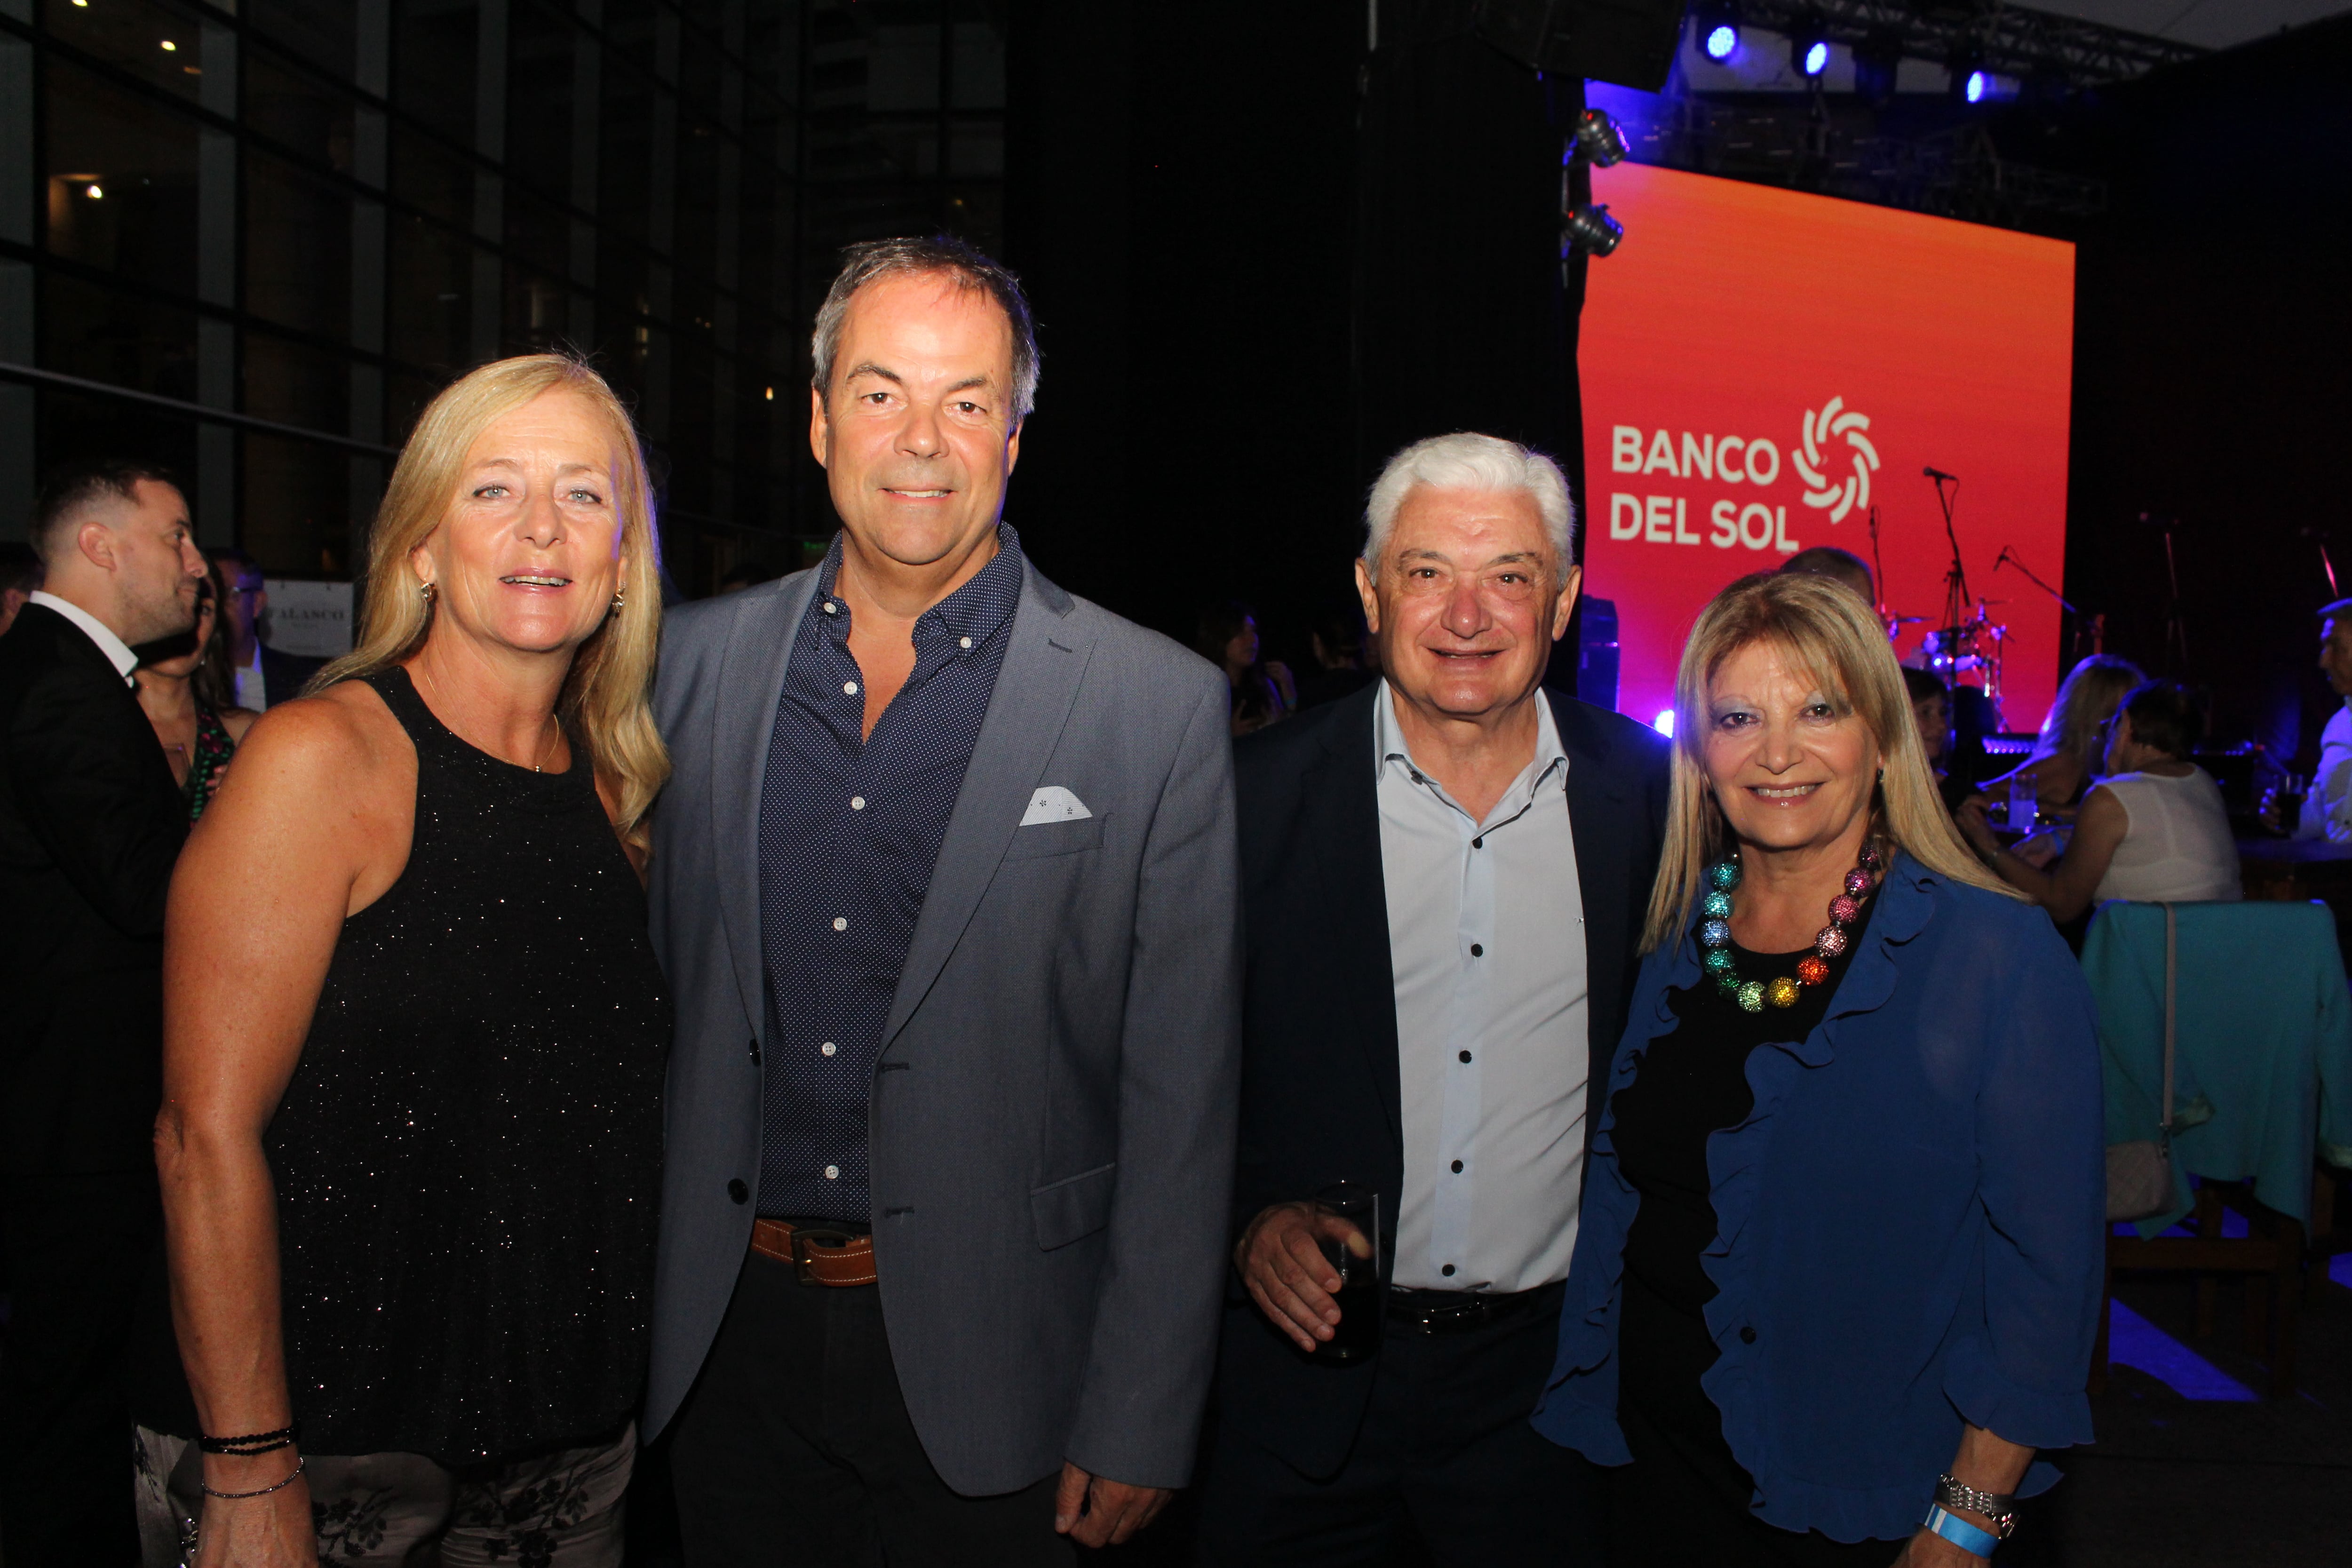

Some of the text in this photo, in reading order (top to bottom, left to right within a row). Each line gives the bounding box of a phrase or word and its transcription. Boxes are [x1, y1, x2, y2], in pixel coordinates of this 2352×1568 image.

[1612, 425, 1780, 486] BANCO
[1610, 493, 1799, 552] DEL SOL
